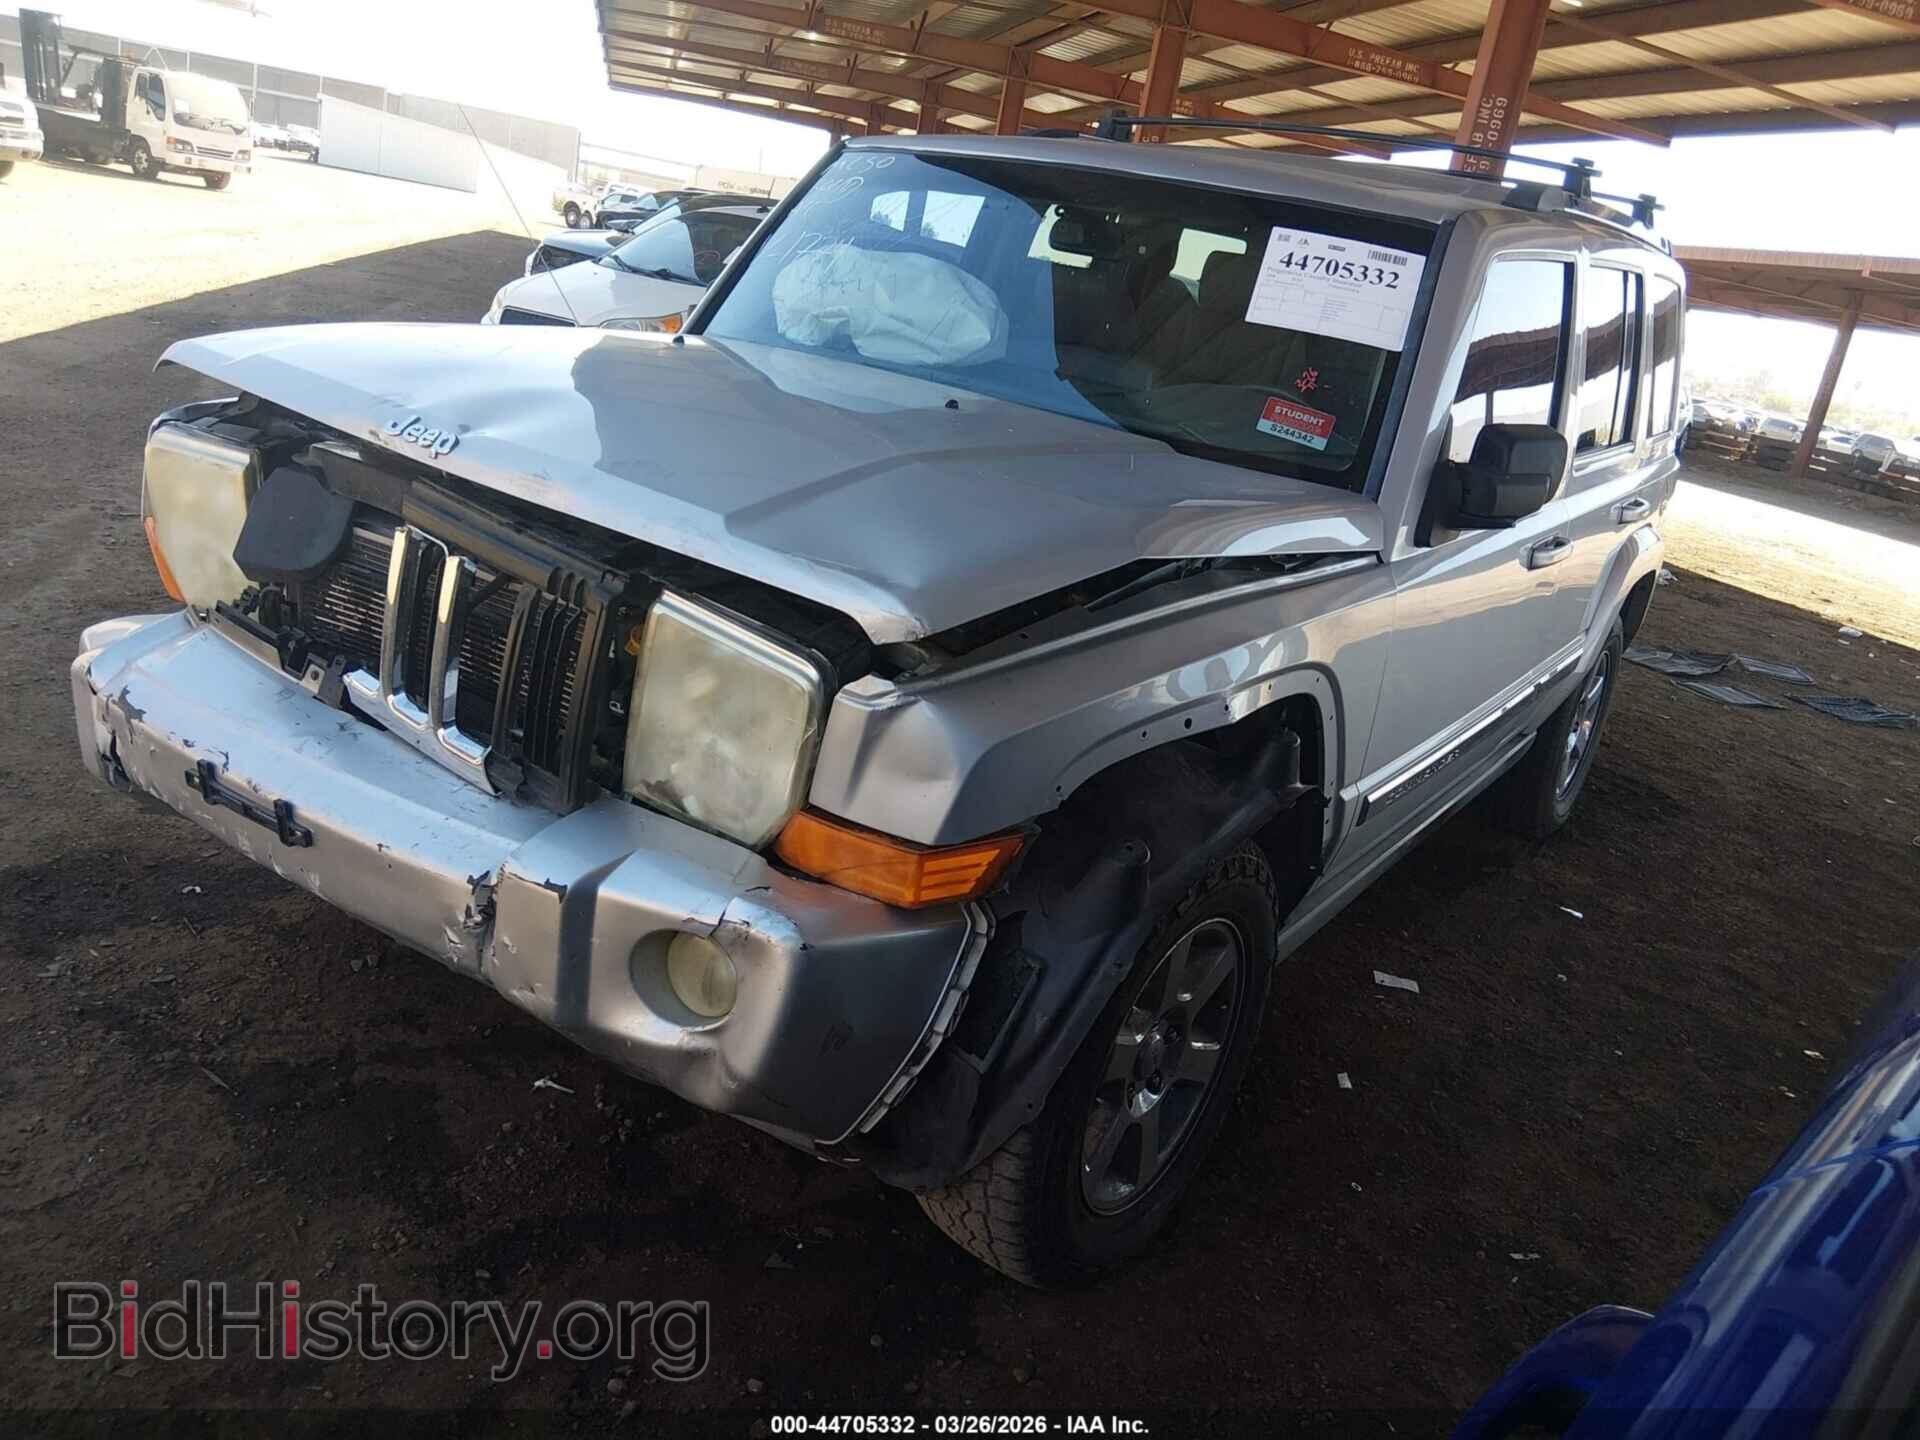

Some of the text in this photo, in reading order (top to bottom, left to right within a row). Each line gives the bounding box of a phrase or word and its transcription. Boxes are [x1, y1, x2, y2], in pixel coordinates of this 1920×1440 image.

[1279, 251, 1400, 289] 44705332
[1274, 405, 1326, 426] STUDENT
[384, 416, 460, 459] Jeep
